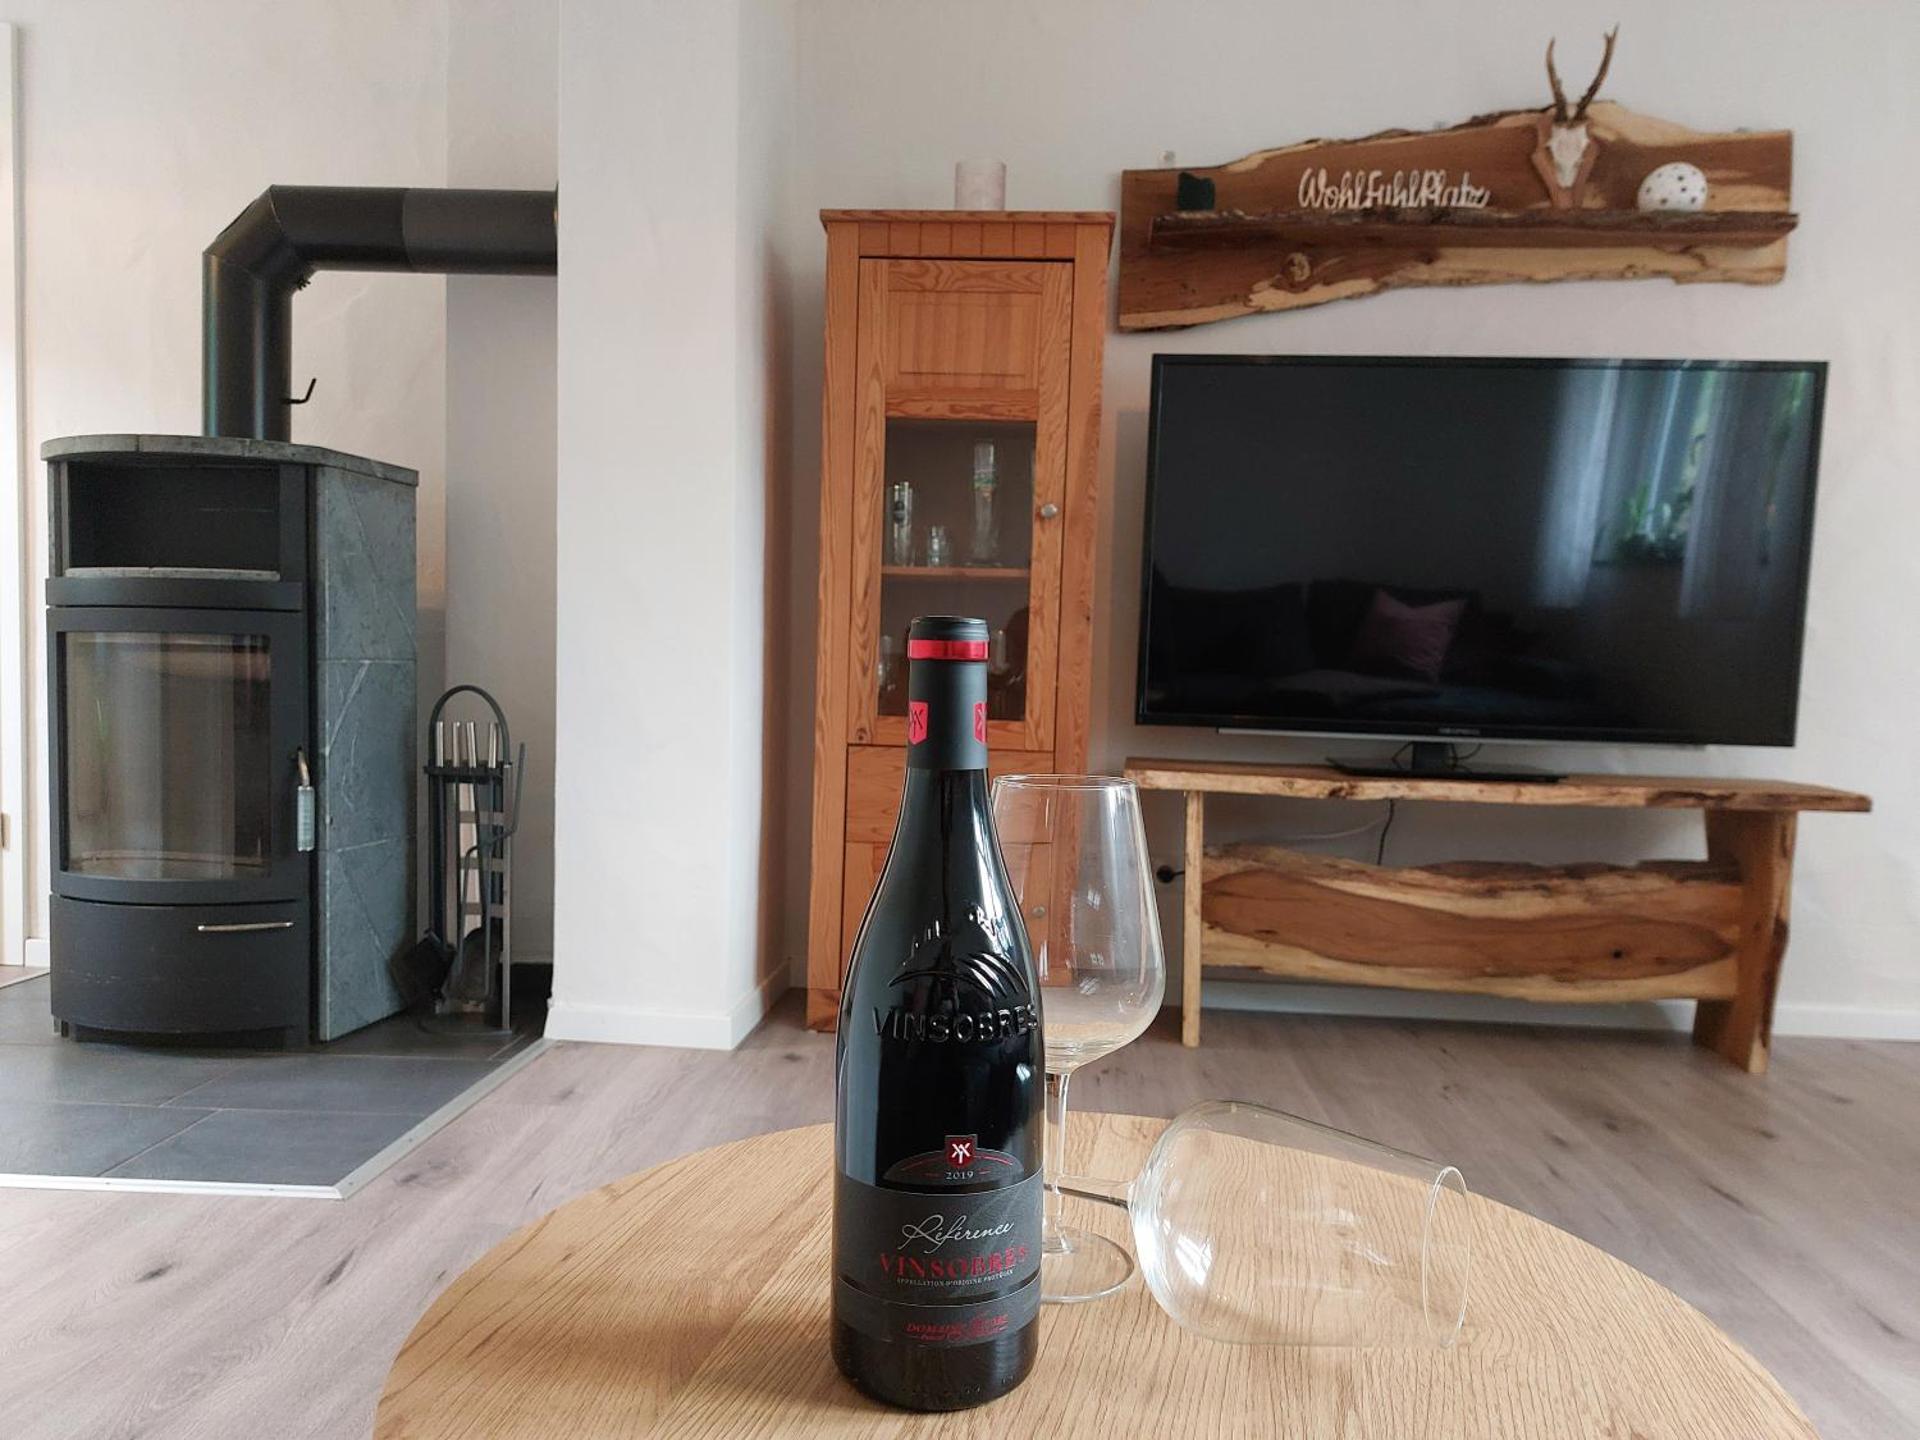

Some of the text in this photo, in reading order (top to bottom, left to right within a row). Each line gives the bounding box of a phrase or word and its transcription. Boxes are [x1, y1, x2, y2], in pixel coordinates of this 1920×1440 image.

[872, 1002, 1038, 1044] VINSOBRES
[945, 1170, 975, 1181] 2019
[898, 1214, 1015, 1254] Référence
[880, 1246, 1028, 1278] VINSOBRES
